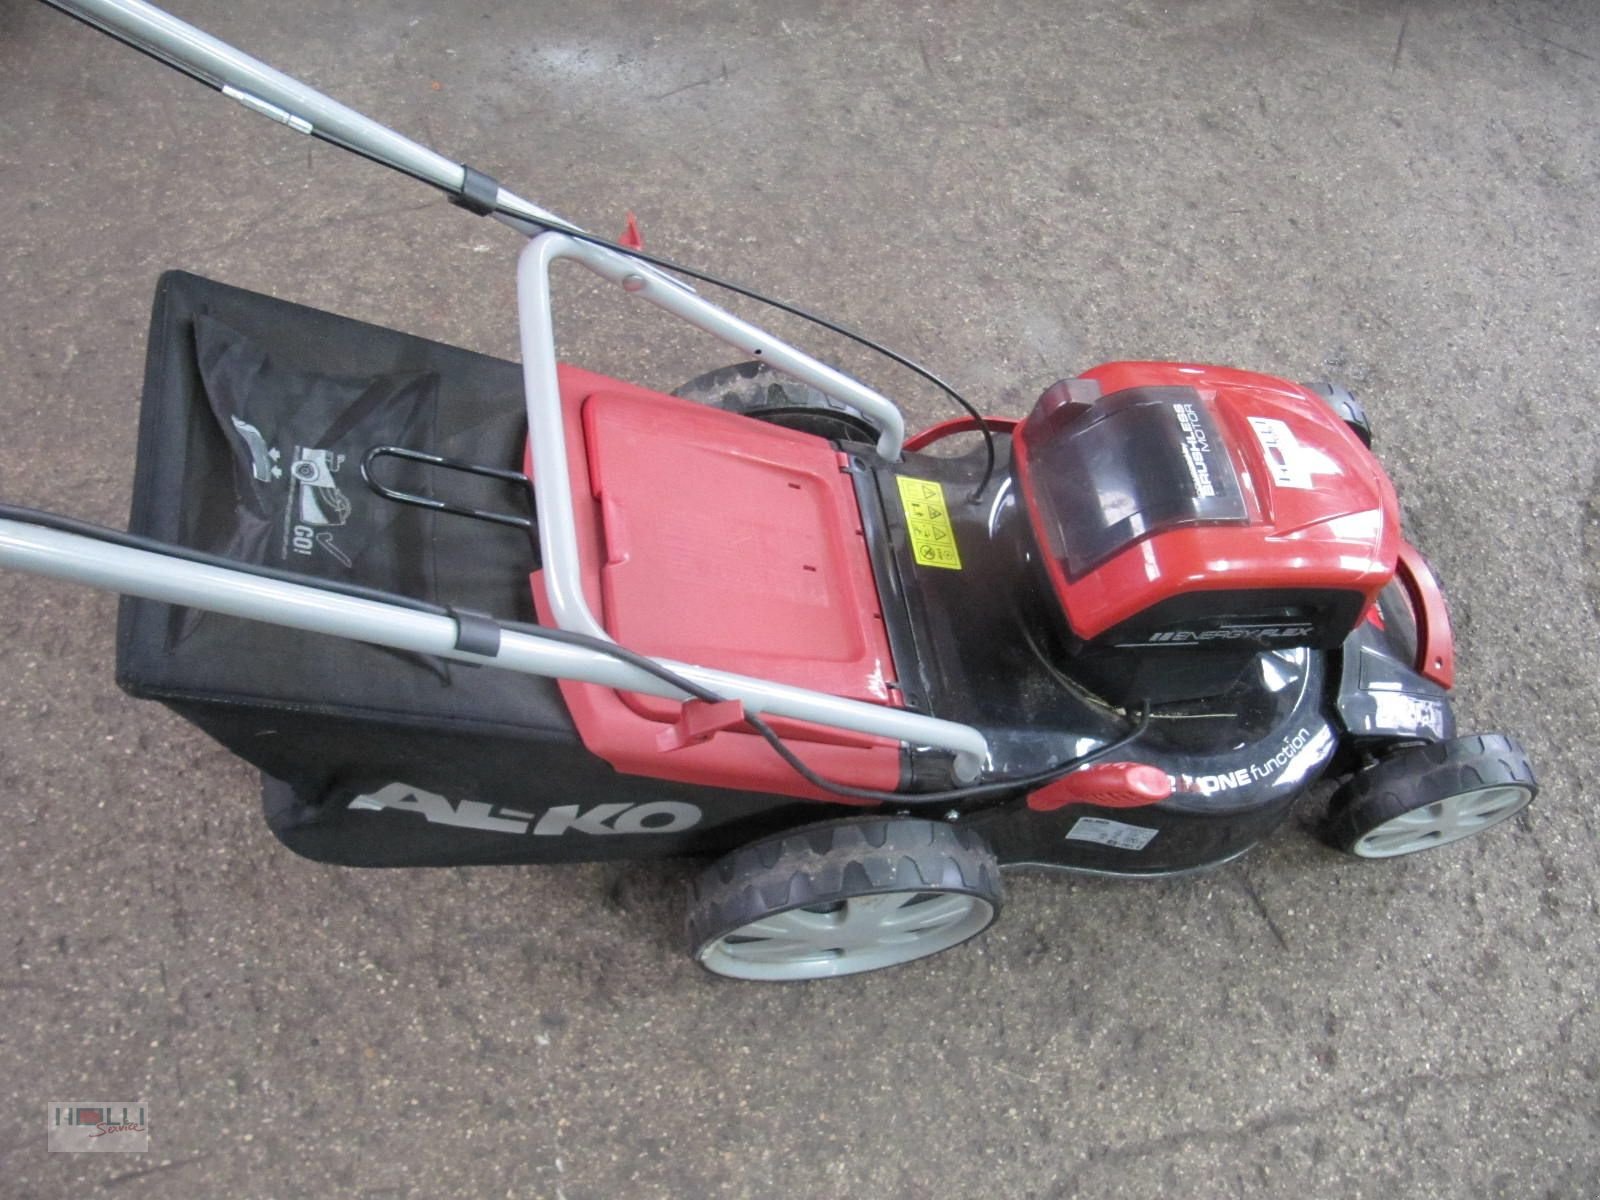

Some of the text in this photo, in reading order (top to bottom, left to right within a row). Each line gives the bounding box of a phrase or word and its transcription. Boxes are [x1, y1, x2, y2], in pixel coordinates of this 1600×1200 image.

[1173, 403, 1215, 497] BRUSHLESS
[1184, 403, 1210, 452] MOTOR
[292, 525, 314, 555] GO!
[1249, 726, 1310, 782] function
[347, 782, 702, 836] AL-KO
